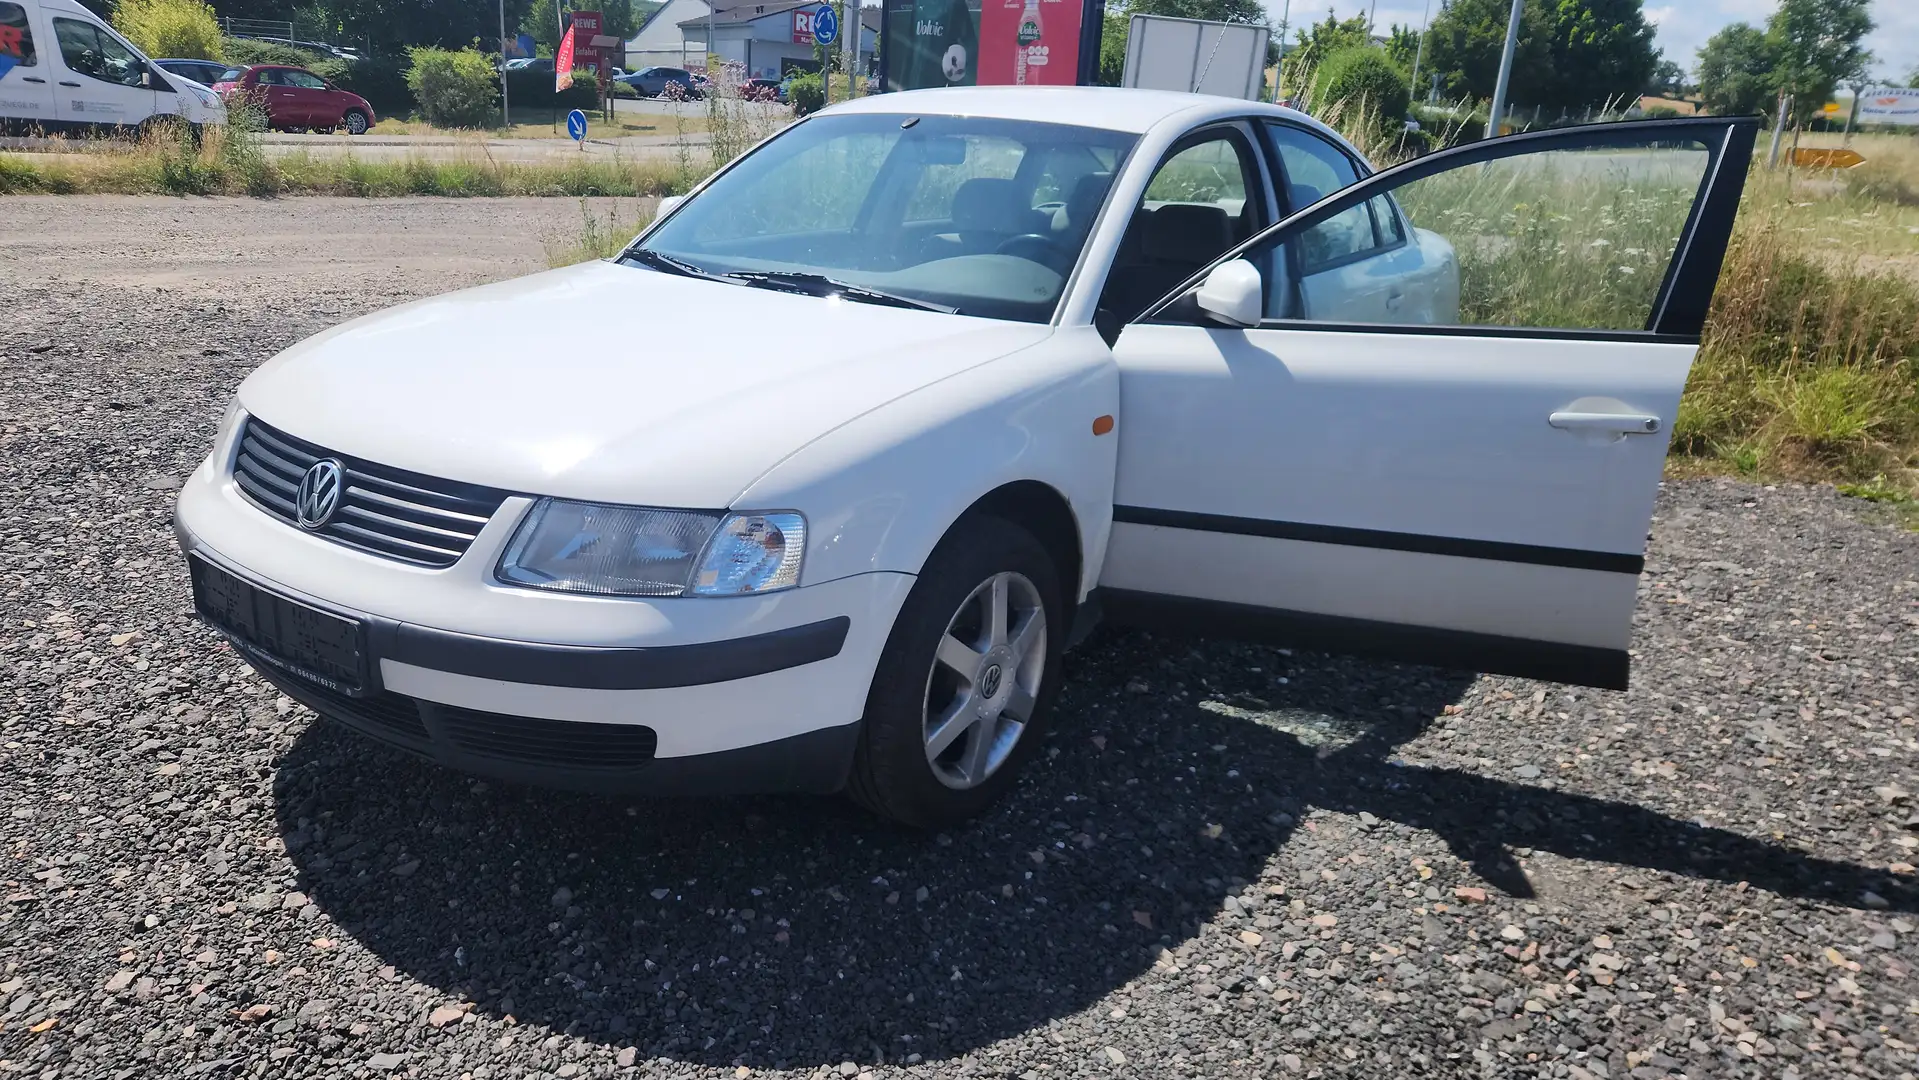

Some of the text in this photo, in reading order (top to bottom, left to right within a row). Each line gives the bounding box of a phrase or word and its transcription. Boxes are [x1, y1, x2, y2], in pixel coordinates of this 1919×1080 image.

[574, 18, 597, 29] REWE
[796, 13, 816, 32] RE
[916, 20, 944, 36] Volvic
[575, 47, 598, 57] Einfahrt
